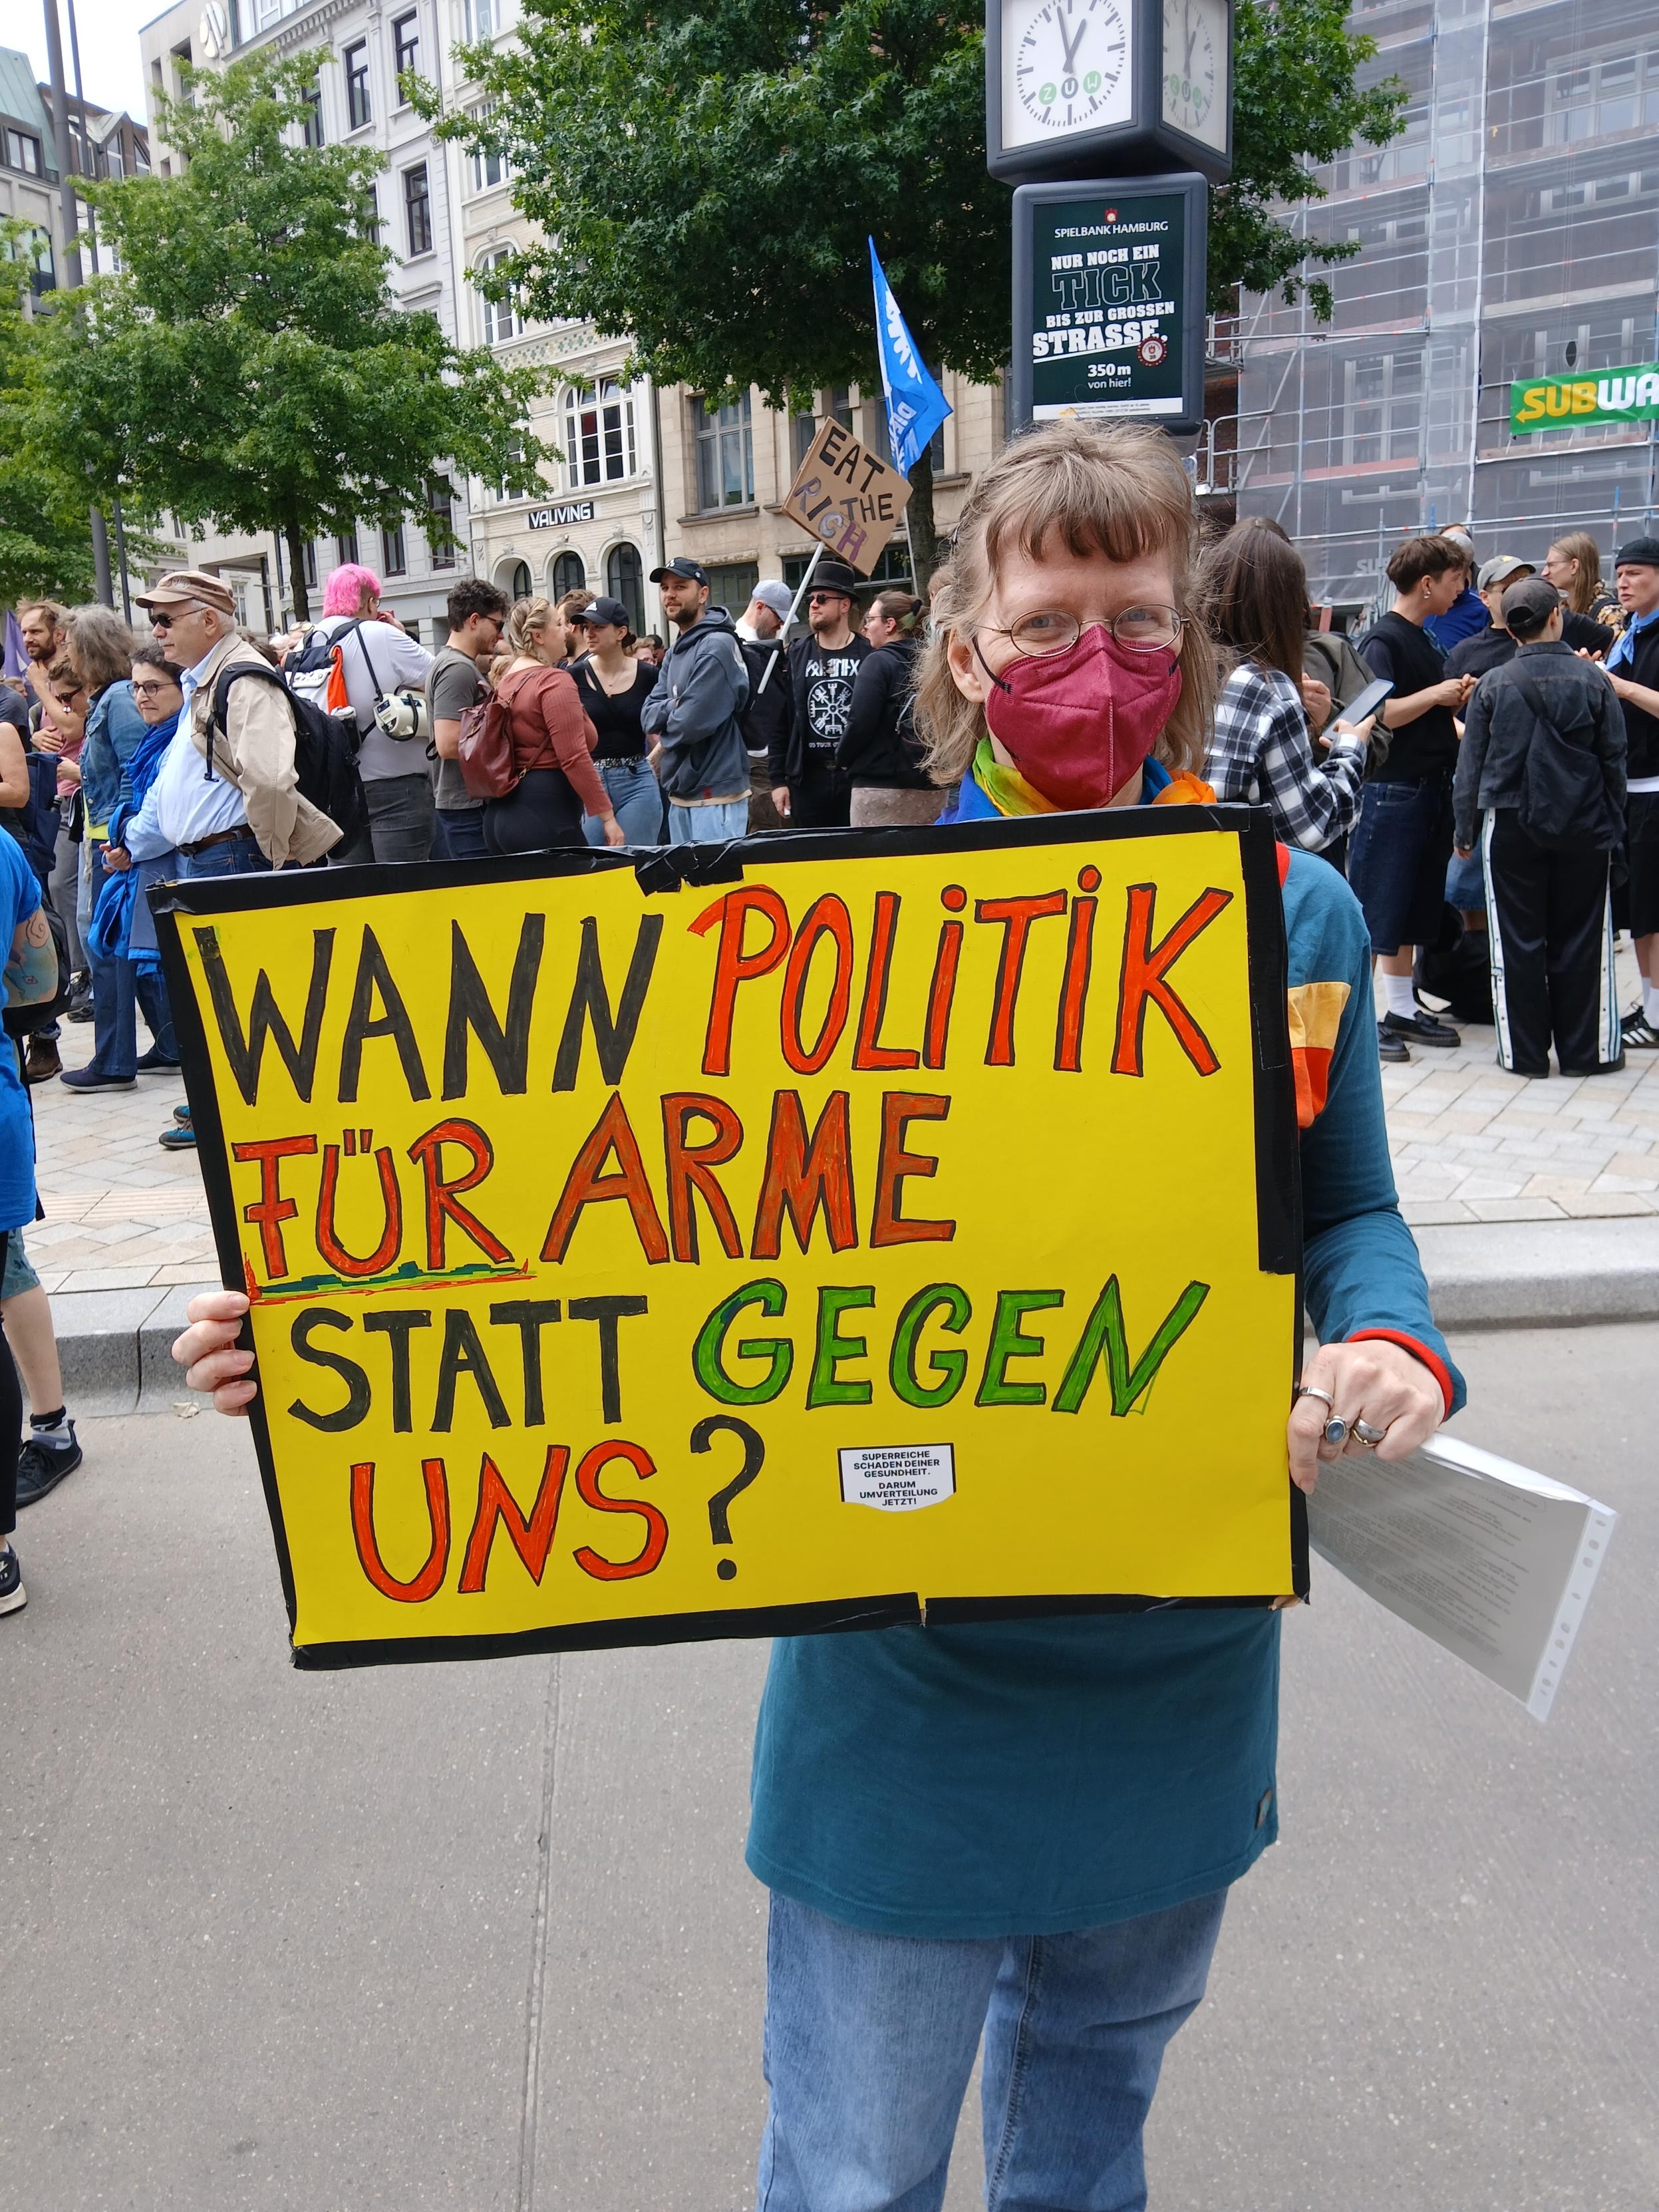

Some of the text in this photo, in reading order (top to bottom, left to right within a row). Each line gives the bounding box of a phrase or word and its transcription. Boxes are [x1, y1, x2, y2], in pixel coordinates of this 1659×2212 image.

[1054, 221, 1169, 239] SPIELBANK HAMBURG
[1051, 243, 1160, 271] NUR NOCH EIN
[1052, 261, 1162, 311] TICK
[1046, 301, 1175, 328] BIS ZUR GROSSEN
[1087, 377, 1132, 389] von hier!
[819, 426, 885, 494] EAT
[794, 476, 867, 563] RICH
[839, 493, 894, 523] THE
[192, 913, 664, 1106] WANN
[231, 1090, 957, 1280] FÜR ARME
[287, 1273, 1211, 1433] STATT GEGEN
[853, 1459, 940, 1470] SCHADEN DEINER
[861, 1450, 931, 1461] SUPERREICHE
[863, 1468, 931, 1478] GESUNDHEIT.
[878, 1481, 916, 1490] DARUM
[859, 1488, 939, 1499] UMVERTEILUNG
[881, 1498, 917, 1506] JETZT!
